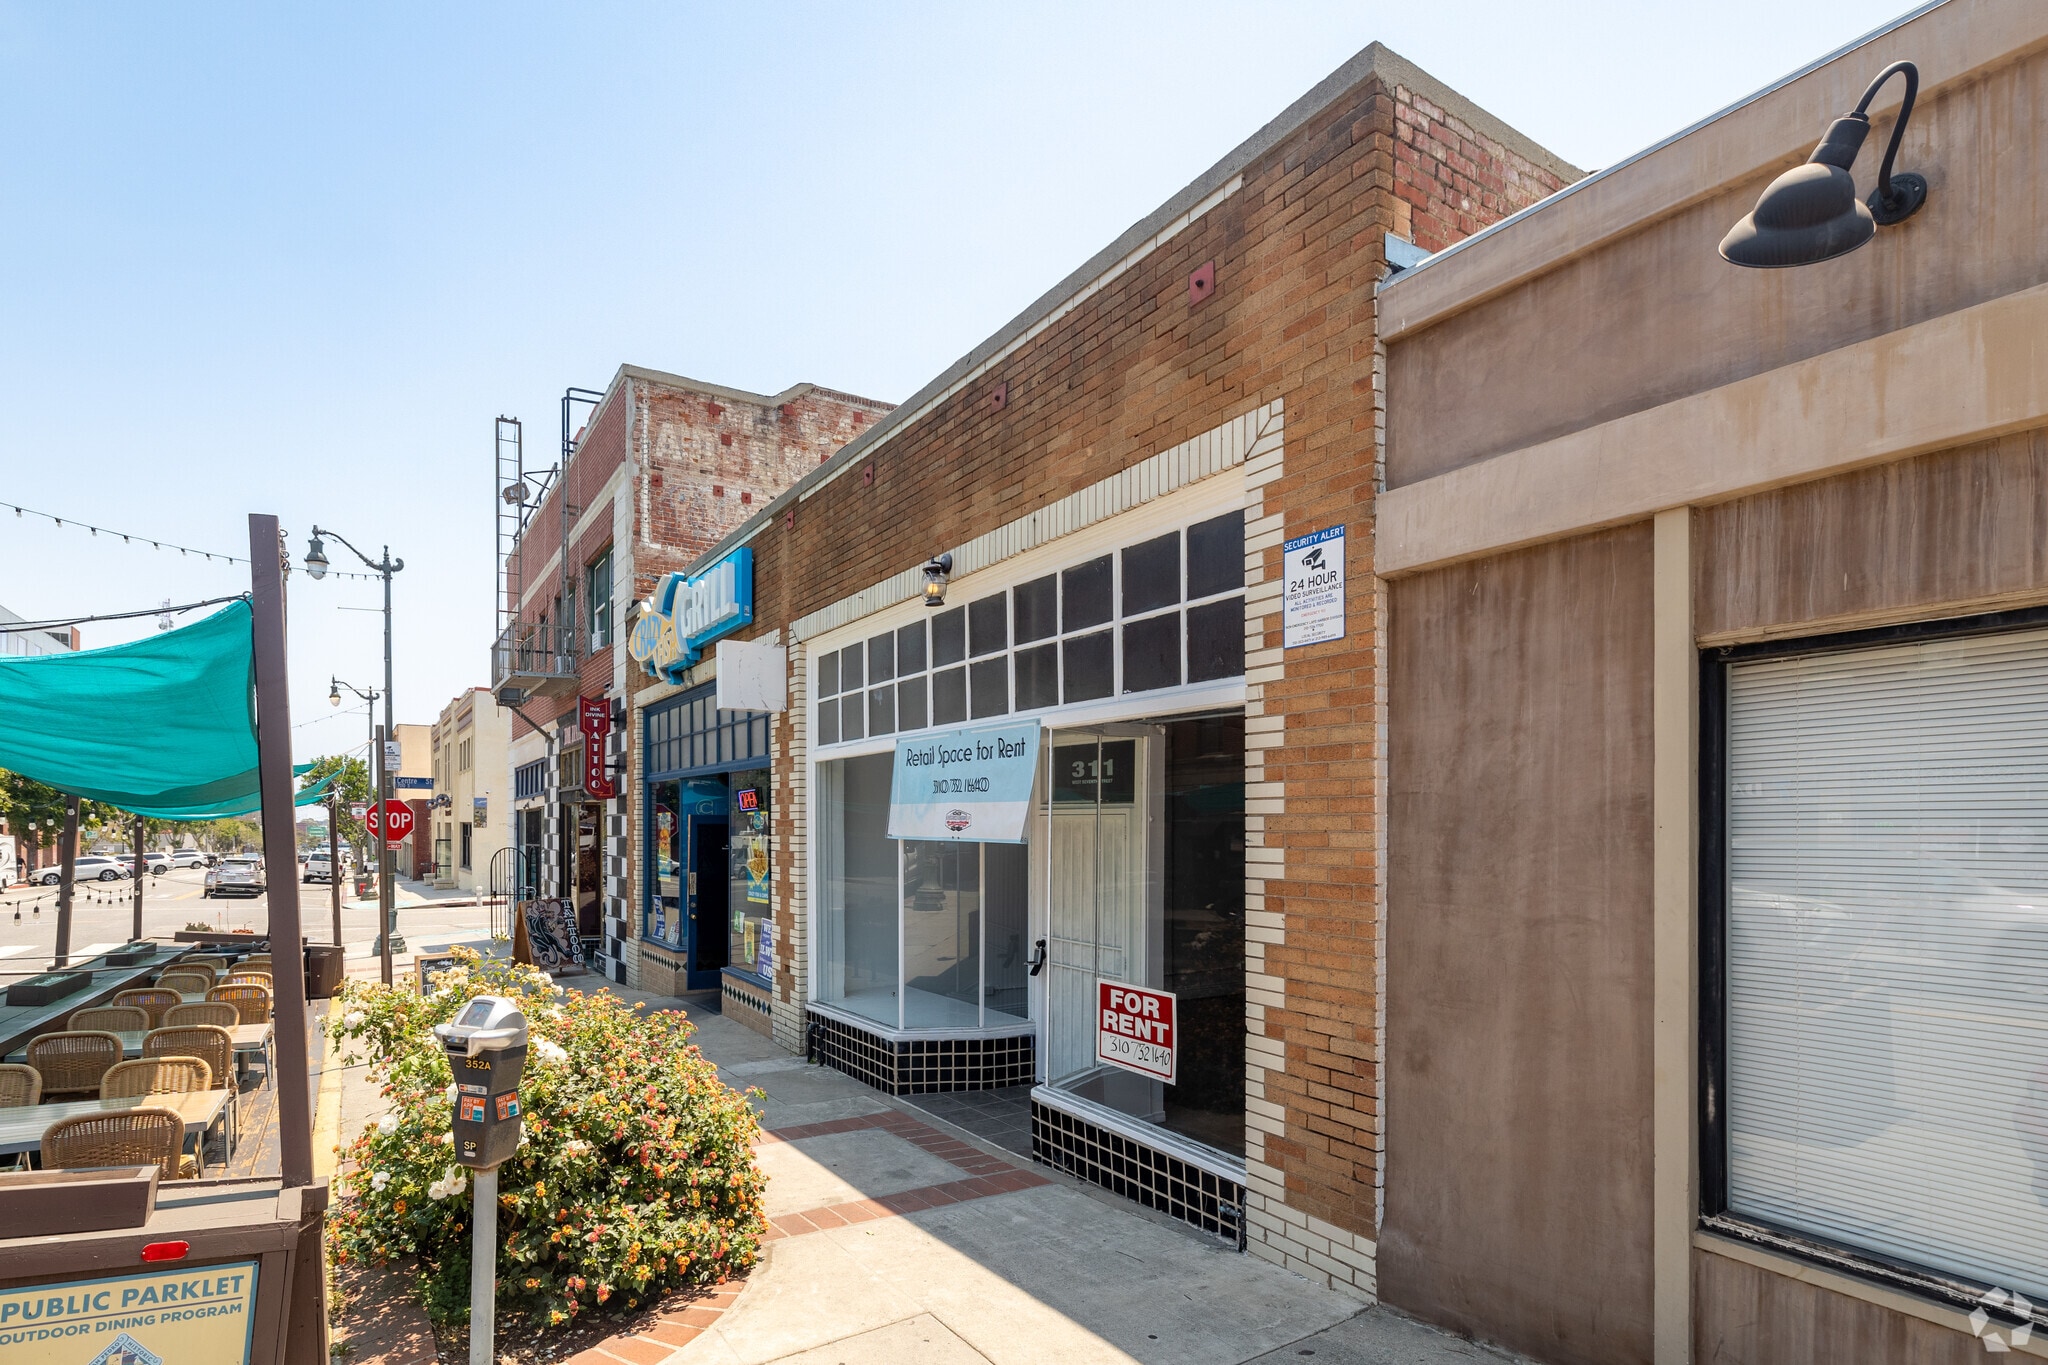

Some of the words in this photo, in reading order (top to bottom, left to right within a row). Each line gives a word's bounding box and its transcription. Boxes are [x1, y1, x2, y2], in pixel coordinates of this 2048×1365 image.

[1284, 534, 1318, 551] SECURITY
[1320, 526, 1344, 541] ALERT
[1286, 592, 1301, 601] VIDEO
[1302, 582, 1343, 597] SURVEILLANCE
[1290, 579, 1304, 592] 24
[1308, 570, 1337, 589] HOUR
[681, 561, 739, 638] GRILL
[634, 615, 661, 657] CRAZY
[591, 719, 600, 789] TATTOO
[906, 746, 935, 767] Retail
[938, 745, 972, 768] Space
[976, 740, 993, 760] for
[998, 737, 1026, 758] Rent
[1071, 758, 1114, 778] 311
[397, 777, 418, 785] Centre
[740, 791, 758, 809] OPEN
[369, 812, 411, 829] SOP
[1110, 988, 1160, 1019] FOR
[1103, 1008, 1169, 1044] RENT
[1109, 1035, 1130, 1054] 310
[1131, 1041, 1150, 1062] 732
[1151, 1046, 1171, 1066] 1640
[465, 1059, 491, 1071] 352A
[463, 1141, 477, 1151] SP
[0, 1291, 111, 1323] PUBLIC
[121, 1275, 245, 1308] PARKLET
[0, 1323, 90, 1345] OUTDOOR
[95, 1314, 155, 1333] DINING
[161, 1303, 242, 1324] PROGRAM
[101, 1342, 120, 1359] PEDRO
[128, 1341, 153, 1361] HISTORIC
